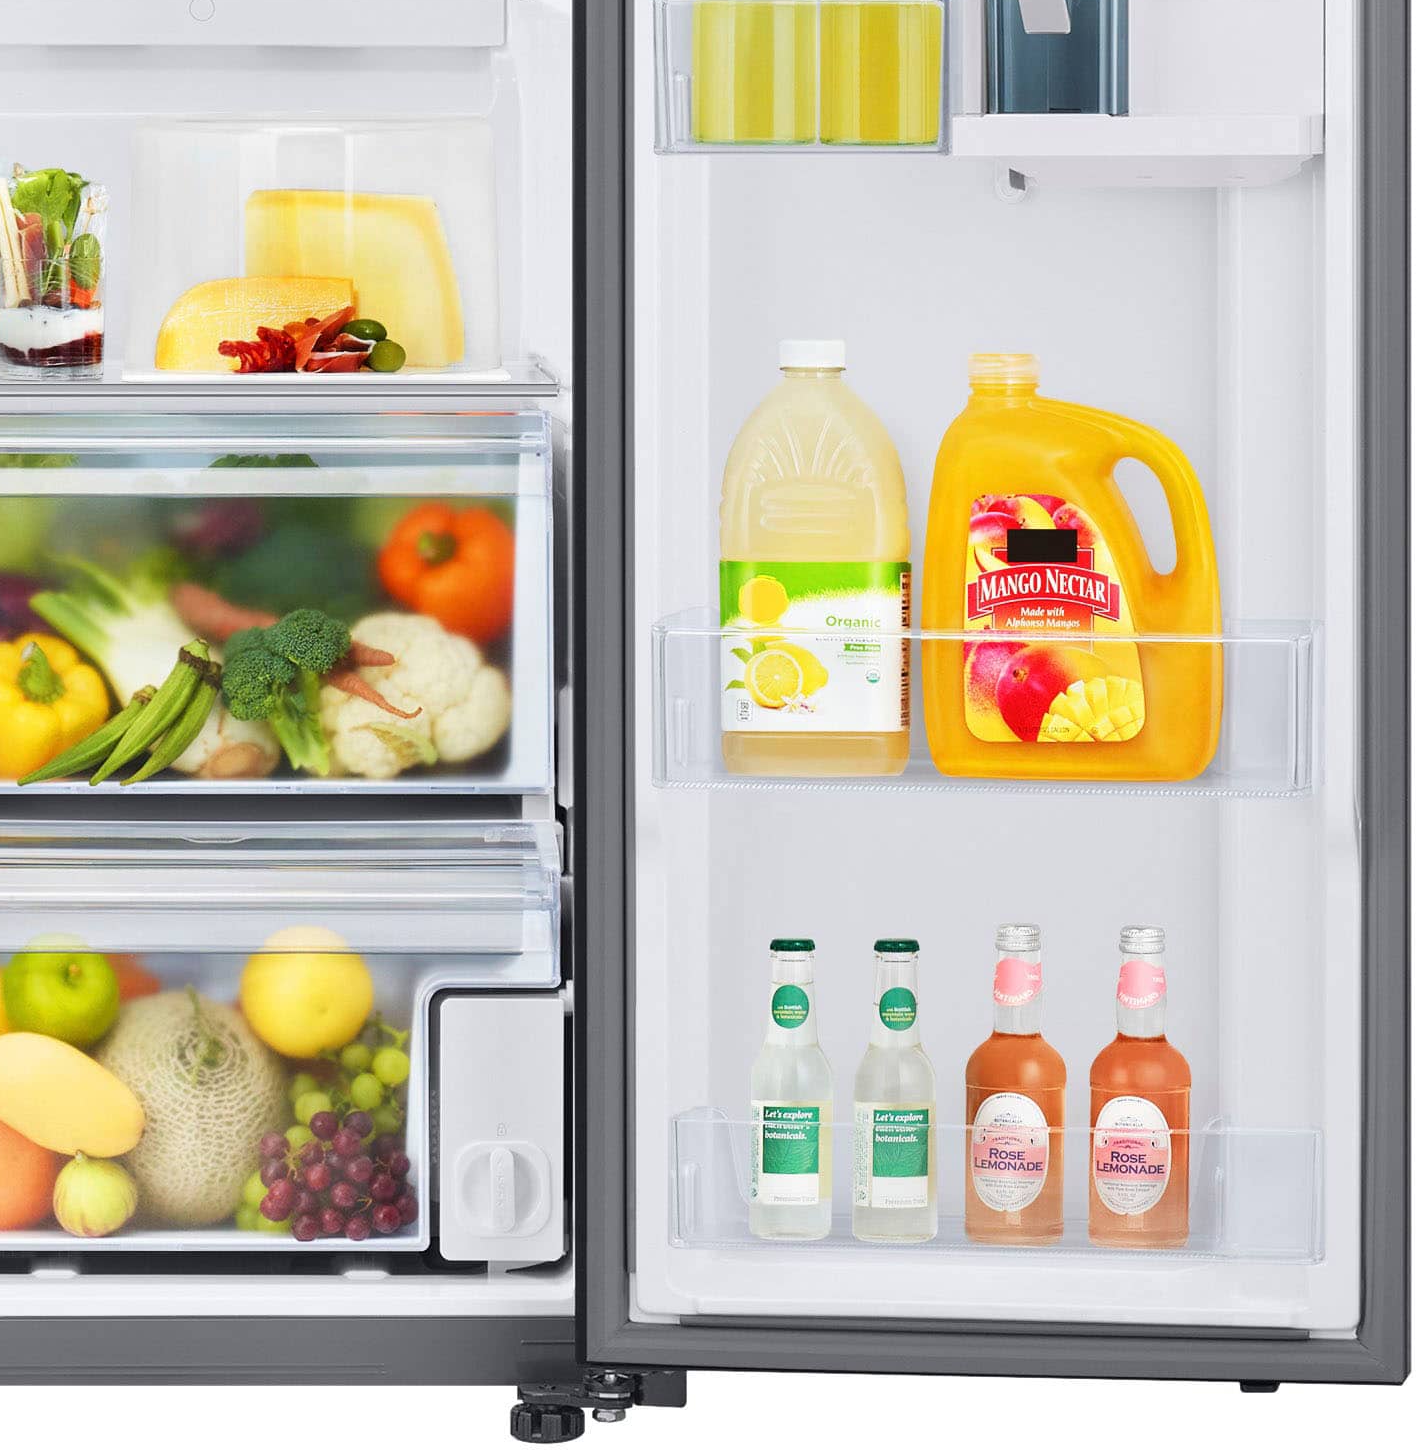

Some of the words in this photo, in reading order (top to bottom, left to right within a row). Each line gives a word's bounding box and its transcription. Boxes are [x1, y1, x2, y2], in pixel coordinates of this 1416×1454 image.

[980, 572, 1042, 603] MANGO
[1045, 568, 1106, 603] NECTAR
[1020, 607, 1045, 616] Made
[1046, 607, 1065, 616] with
[825, 615, 881, 628] Organic
[1005, 618, 1045, 628] Alphonso
[1046, 619, 1080, 629] Mangos
[765, 1109, 782, 1118] Let's
[783, 1110, 813, 1121] explore
[875, 1113, 893, 1122] Let's
[894, 1113, 924, 1123] explore
[765, 1131, 807, 1140] botanicals.
[875, 1134, 918, 1143] botanicals.
[989, 1148, 1026, 1161] ROSE
[1110, 1151, 1147, 1164] ROSE
[974, 1157, 1044, 1171] LEMONADE
[1096, 1161, 1165, 1174] LEMONADE
